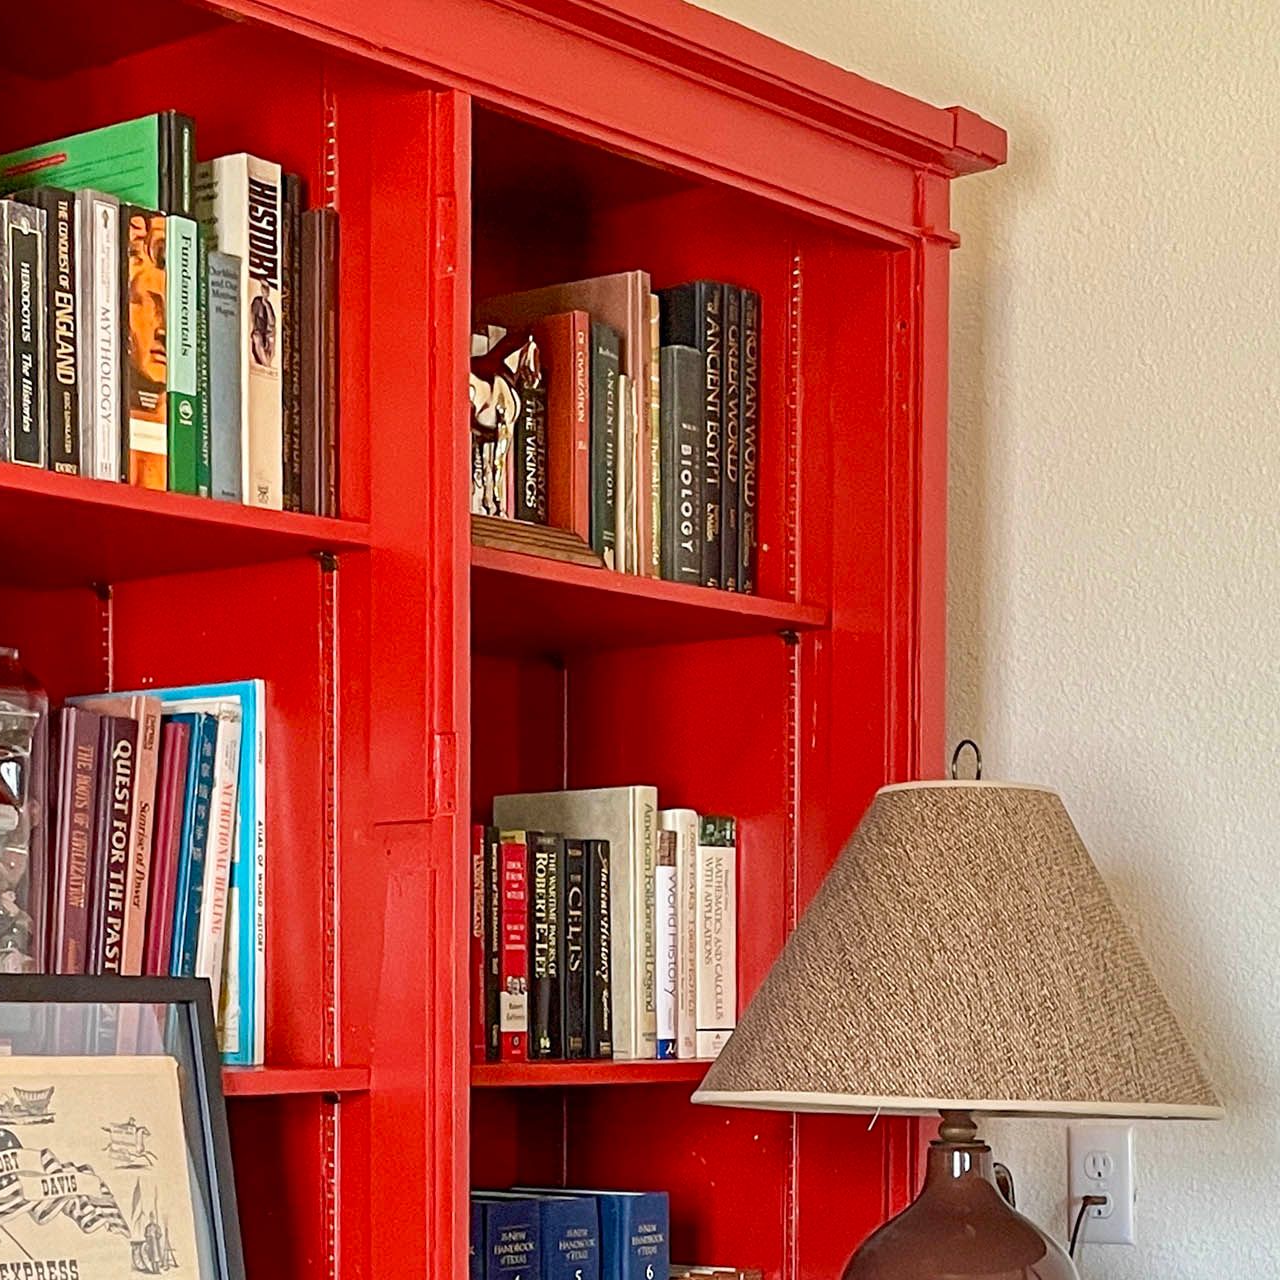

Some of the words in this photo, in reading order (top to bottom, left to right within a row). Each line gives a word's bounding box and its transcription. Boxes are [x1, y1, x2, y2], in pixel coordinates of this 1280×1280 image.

[248, 175, 279, 291] HISTORY
[20, 262, 32, 343] HERODOTUS
[180, 235, 193, 357] Fundamentals
[99, 306, 113, 423] MYTHOLOGY
[706, 316, 721, 414] ANCIENT
[745, 329, 757, 419] ROMAN
[525, 399, 536, 431] THE
[525, 436, 538, 508] VIKINGS
[706, 420, 721, 488] EGYPT
[745, 425, 757, 507] WORLD
[680, 444, 694, 553] BIOLOGY
[111, 738, 132, 814] QUEST
[109, 820, 129, 864] FOR
[215, 781, 233, 873] NUTRITIONAL
[107, 867, 126, 912] THE
[210, 875, 226, 935] HEALING
[713, 857, 724, 934] MATHEMATICS
[104, 916, 124, 974] PAST
[568, 886, 583, 972] CELTS
[714, 937, 724, 961] AND
[714, 962, 725, 1020] CALCULUS
[41, 1174, 78, 1196] DAVIS
[493, 1242, 534, 1256] HANDBOOK
[646, 1264, 655, 1280] 6
